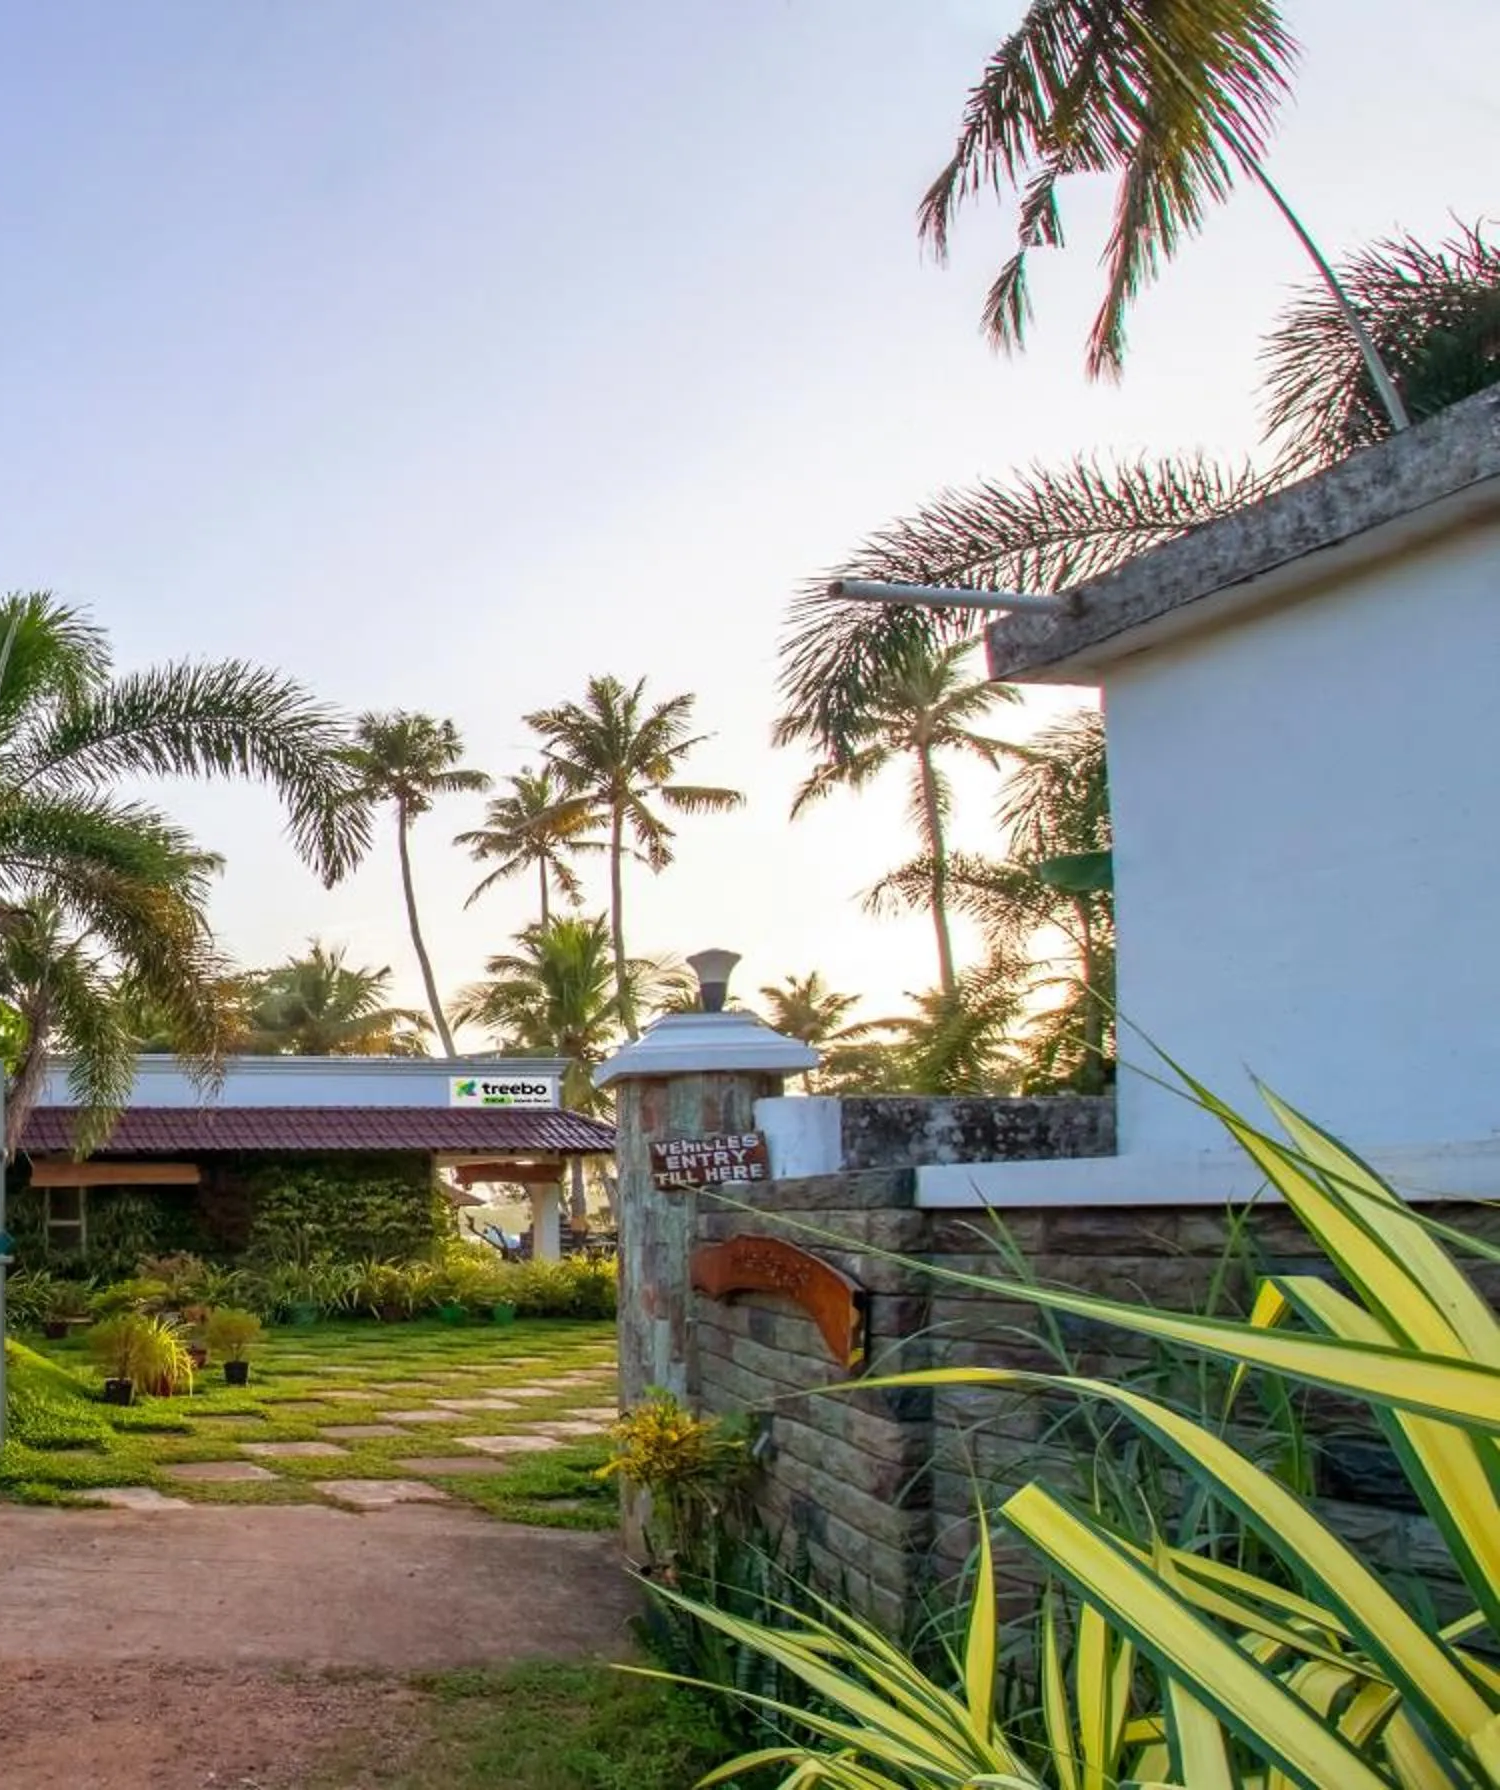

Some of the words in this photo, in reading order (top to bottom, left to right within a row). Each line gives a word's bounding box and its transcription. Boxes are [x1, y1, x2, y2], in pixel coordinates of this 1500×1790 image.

[481, 1082, 547, 1095] treebo
[665, 1150, 748, 1170] ENTRY
[654, 1170, 699, 1185] TILL
[705, 1163, 764, 1182] HERE
